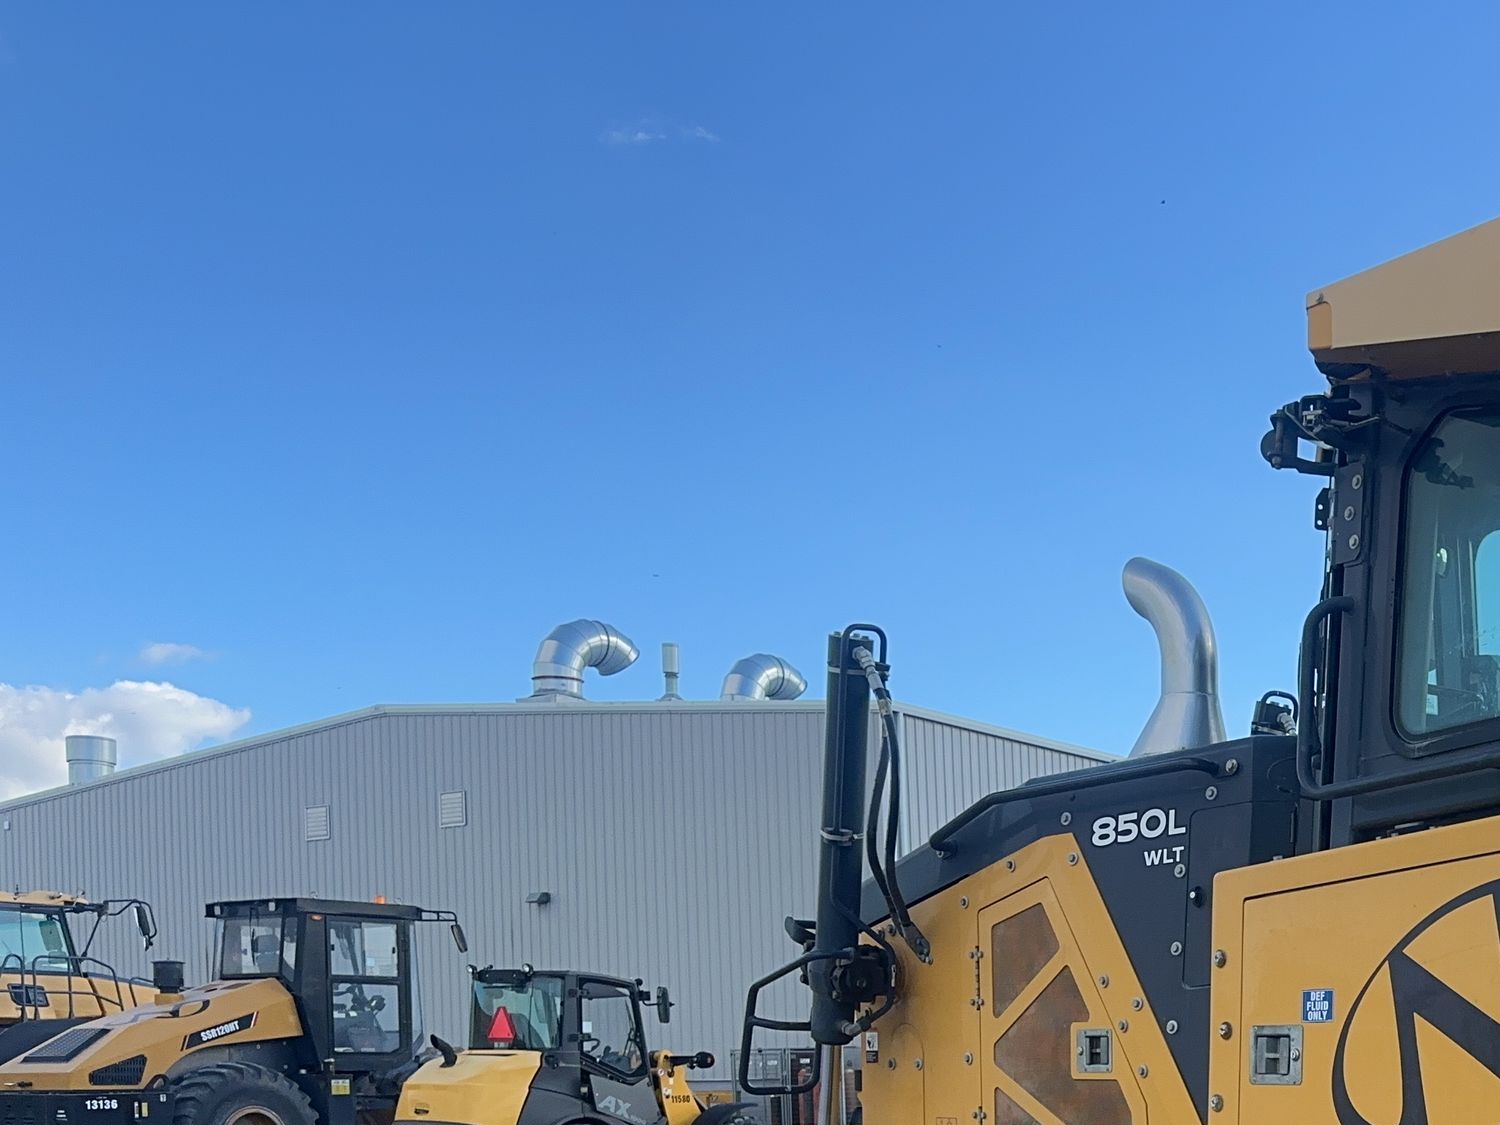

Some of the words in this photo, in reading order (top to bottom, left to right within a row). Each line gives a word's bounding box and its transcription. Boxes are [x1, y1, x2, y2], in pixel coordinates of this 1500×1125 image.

[1091, 808, 1186, 847] 850L
[1143, 846, 1185, 867] WLT
[1310, 991, 1326, 1002] DEF
[1306, 1001, 1329, 1011] FLUID
[1307, 1010, 1328, 1021] ONLY
[85, 1099, 118, 1111] 13136
[671, 1095, 691, 1104] 11580
[599, 1095, 632, 1119] AX
